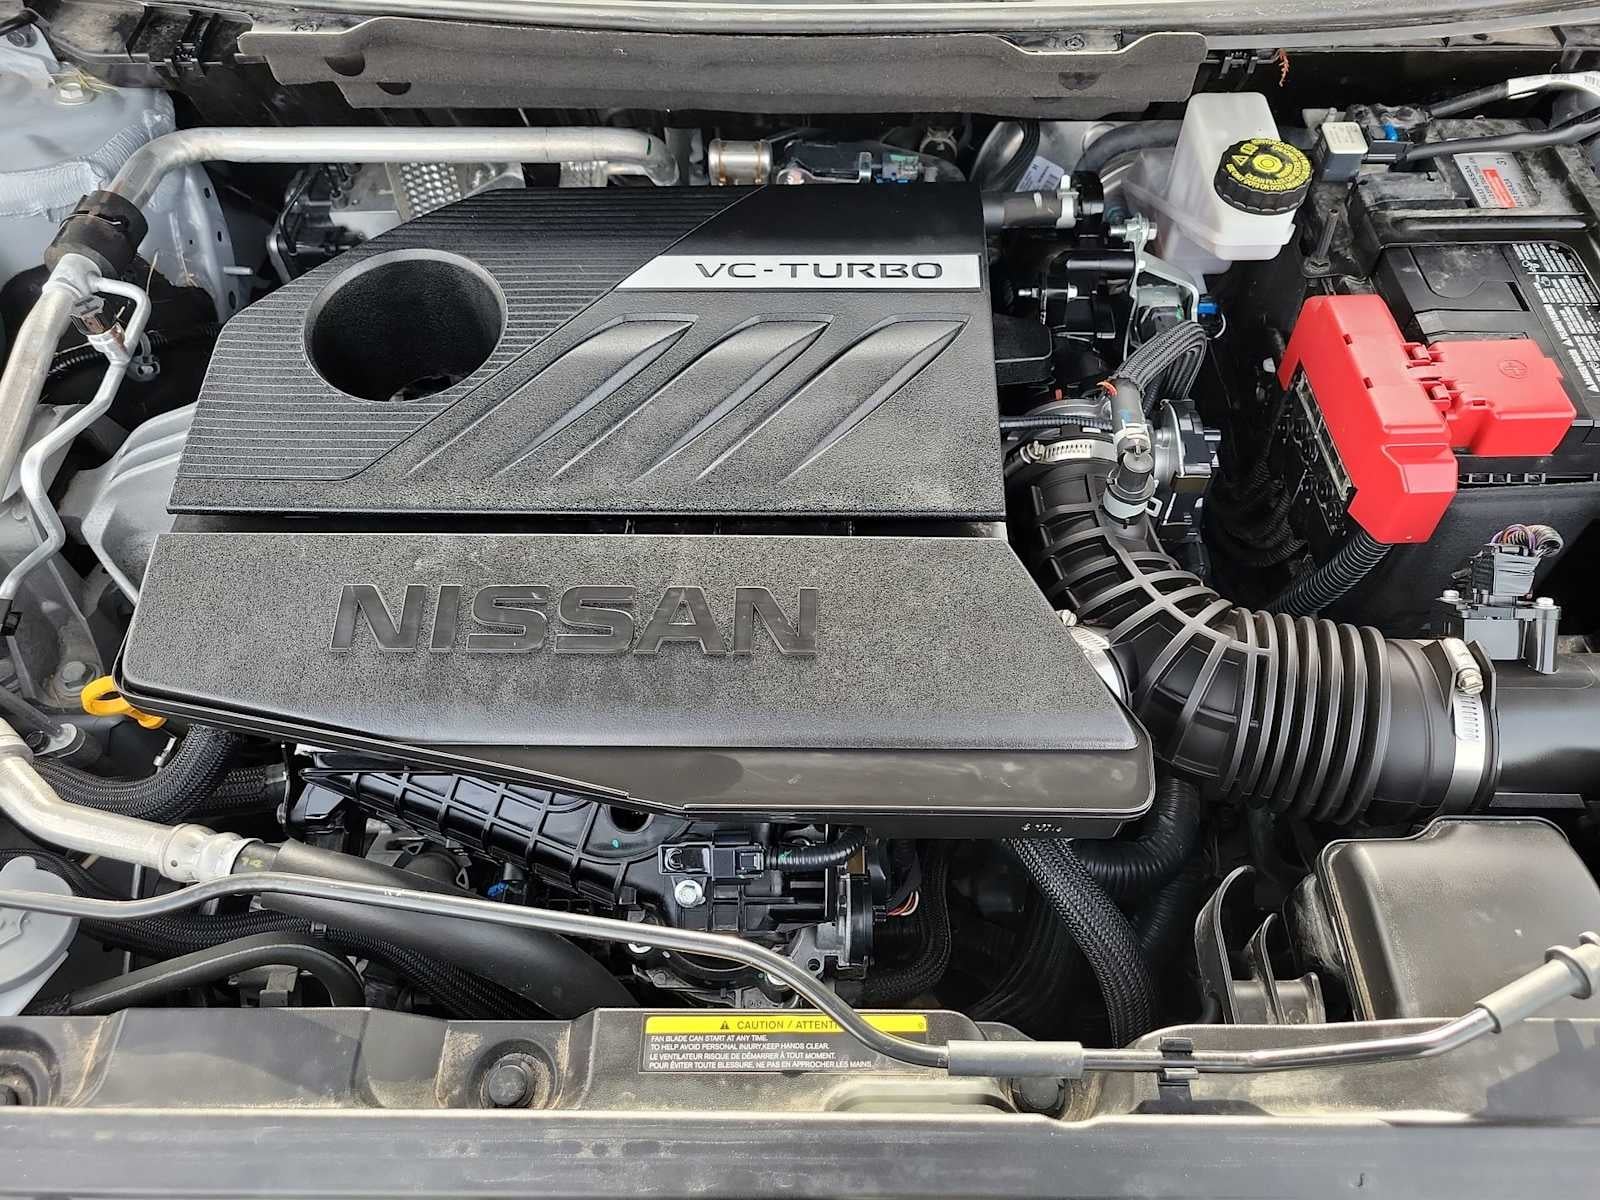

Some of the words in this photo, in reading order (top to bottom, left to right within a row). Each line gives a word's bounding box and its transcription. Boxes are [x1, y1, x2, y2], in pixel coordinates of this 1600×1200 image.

[695, 262, 943, 279] VC-TURBO
[329, 584, 820, 655] NISSAN
[737, 1020, 784, 1030] CAUTION
[796, 1020, 839, 1030] ATTENTI
[741, 1051, 779, 1060] DÉMARRER
[670, 1060, 693, 1069] ÉVITER
